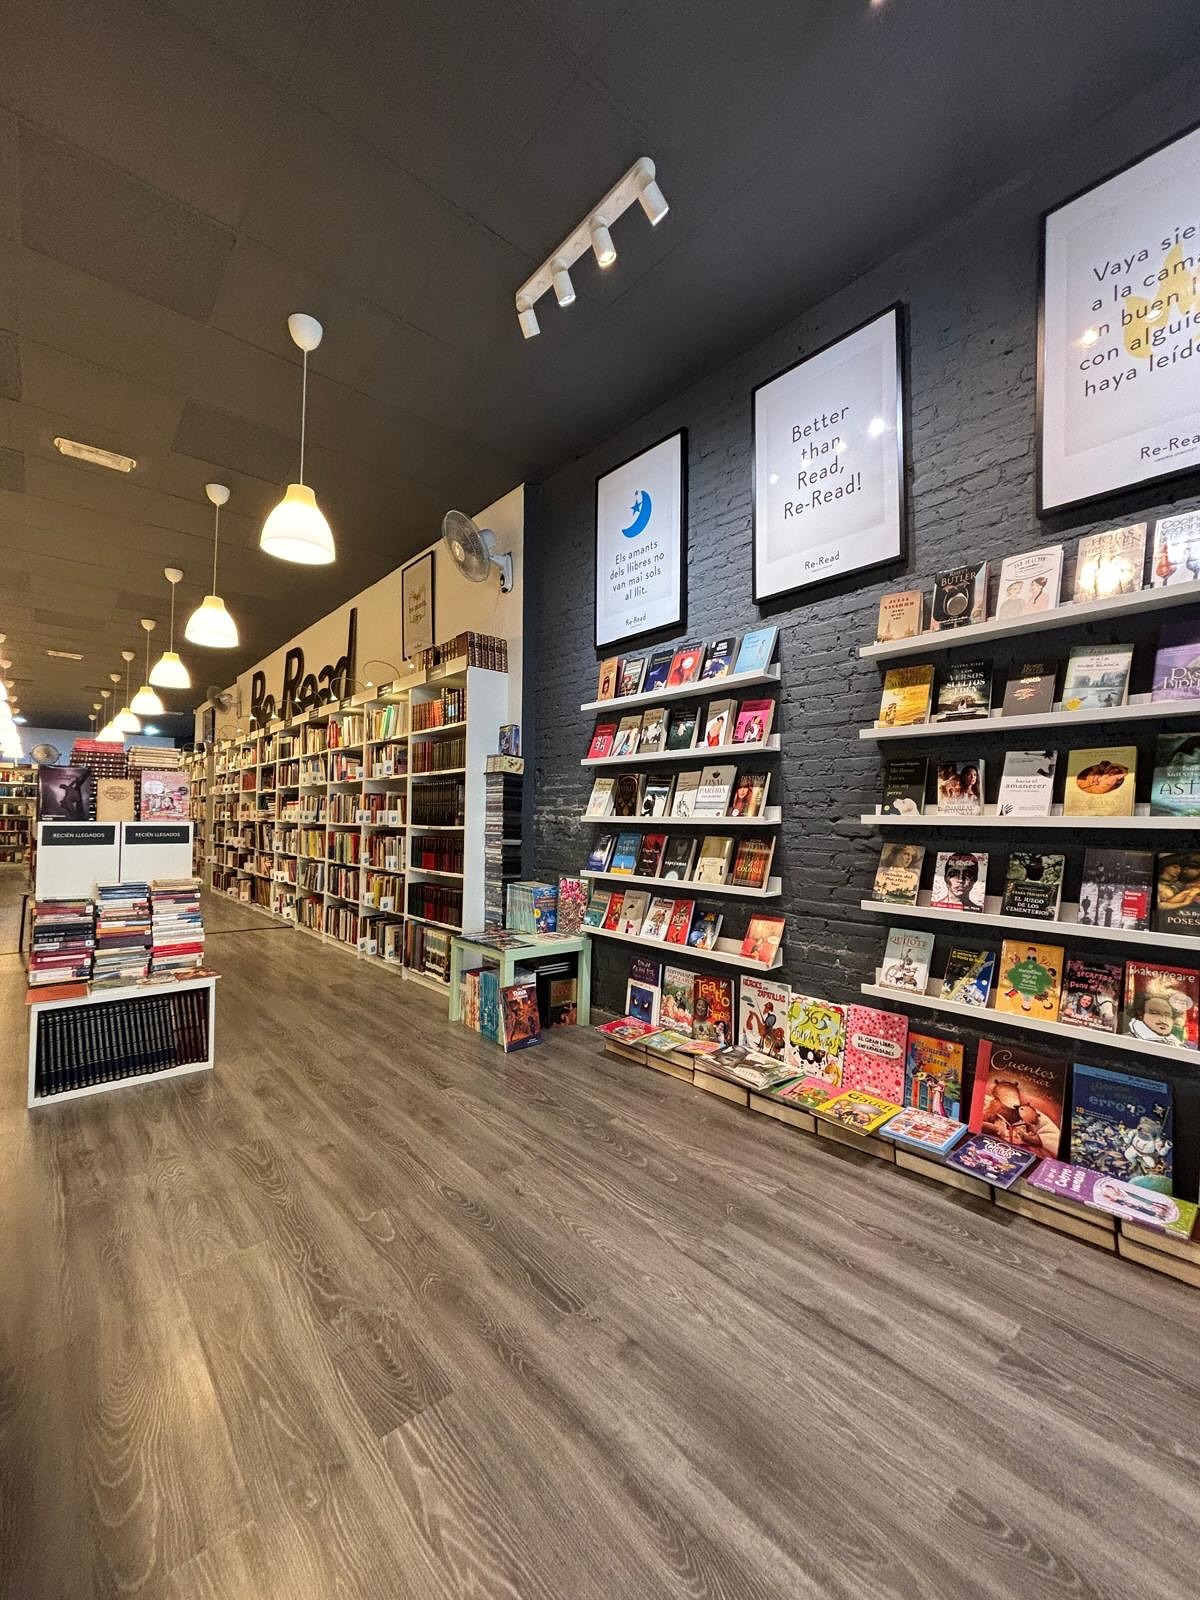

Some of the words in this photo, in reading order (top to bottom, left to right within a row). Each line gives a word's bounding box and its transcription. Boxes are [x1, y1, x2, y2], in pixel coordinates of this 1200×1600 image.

[1093, 249, 1149, 282] Vaya
[1091, 299, 1103, 312] a
[1114, 284, 1132, 302] la
[1143, 255, 1200, 287] cam
[1122, 292, 1179, 328] buen
[1079, 347, 1119, 371] con
[1085, 368, 1137, 397] haya
[791, 405, 850, 443] Better
[801, 436, 842, 462] than
[797, 454, 845, 490] Read,
[783, 471, 862, 520] Re-Read!
[609, 567, 625, 580] dels
[626, 558, 652, 574] llibres
[654, 551, 665, 563] no
[615, 552, 626, 565] Els
[628, 540, 658, 560] amants
[804, 551, 841, 571] Re-Read
[612, 582, 626, 592] van
[628, 571, 643, 586] mai
[645, 565, 662, 580] sols
[941, 571, 978, 587] BUTLER
[624, 589, 632, 601] al
[1005, 906, 1049, 916] CEMENTERIOS
[1129, 964, 1196, 983] Shakespeare
[695, 979, 730, 1007] Teatro
[803, 1005, 832, 1031] 365
[991, 1050, 1054, 1079] Cuentos
